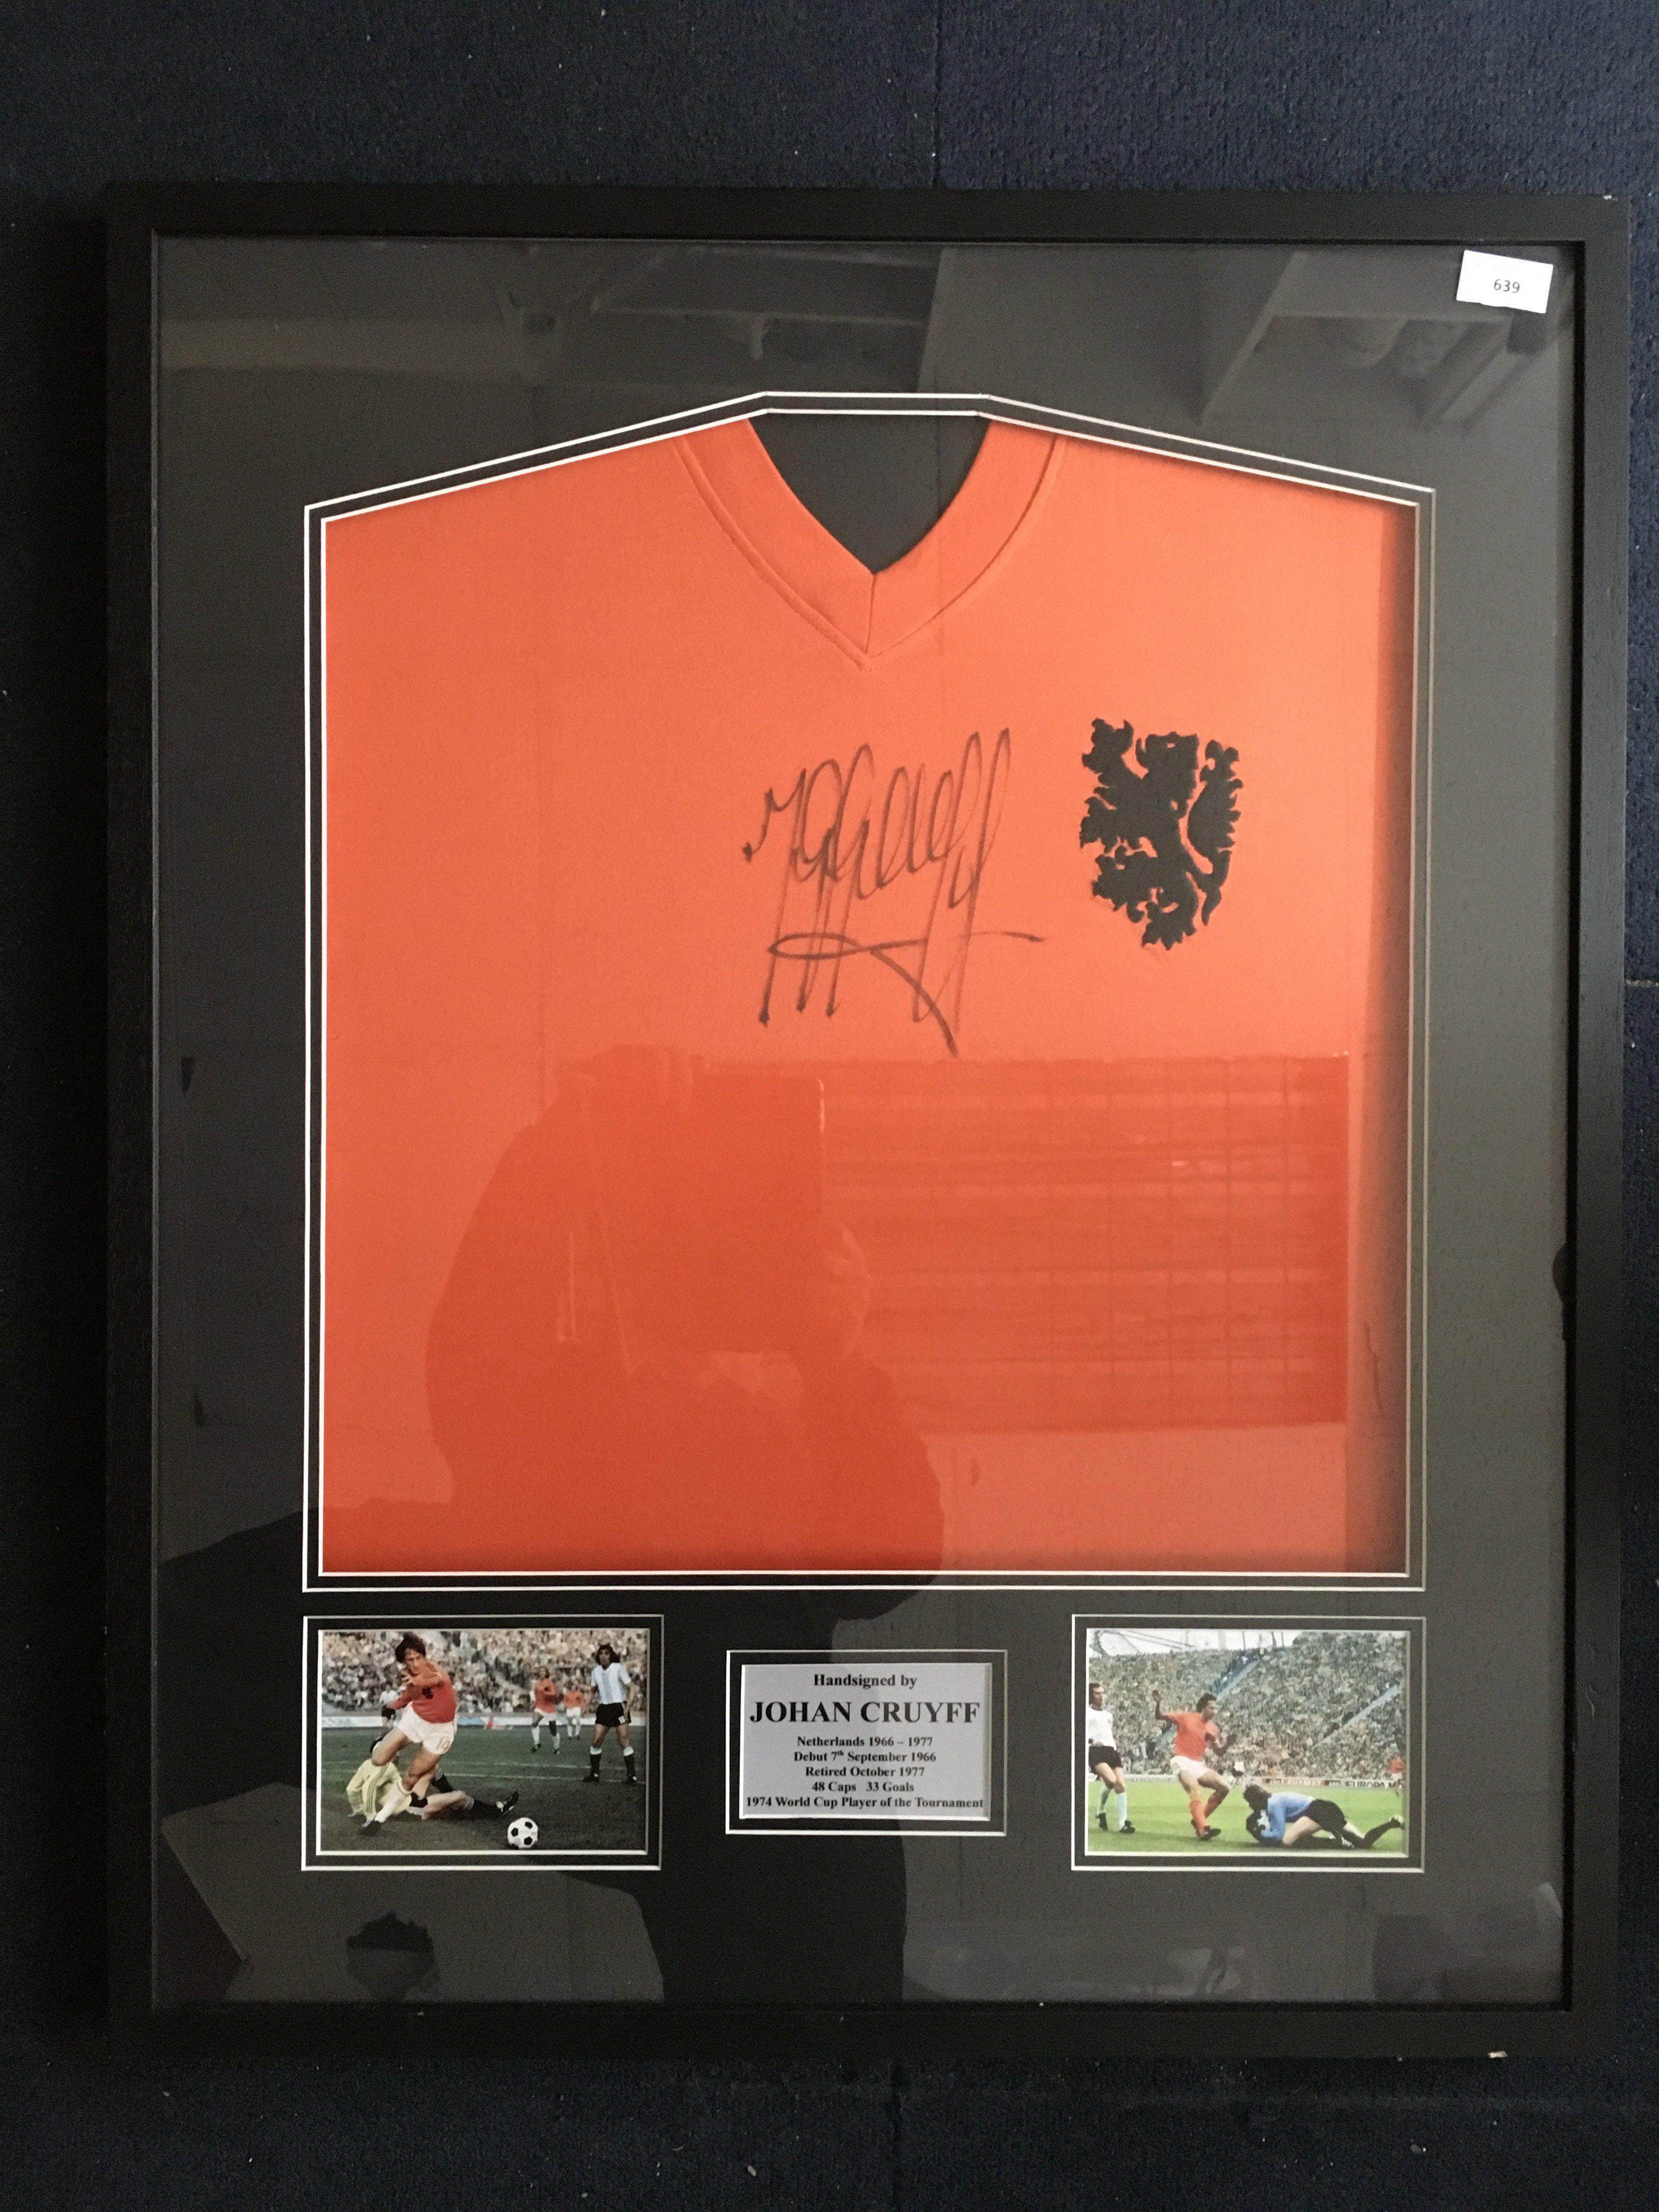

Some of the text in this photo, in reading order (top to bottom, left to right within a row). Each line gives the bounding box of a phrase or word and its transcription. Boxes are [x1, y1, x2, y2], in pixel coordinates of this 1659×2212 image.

[1493, 279, 1520, 293] 639
[814, 1674, 917, 1689] Handsigned by
[750, 1701, 980, 1723] JOHAN CRUYFF
[797, 1736, 865, 1746] Netherlands
[870, 1736, 894, 1747] 1966
[909, 1737, 933, 1747] 1977
[794, 1750, 937, 1764] Debut 7th September 1966
[805, 1766, 924, 1777] Retired October 1977
[812, 1781, 915, 1794] 48 Caps 33 Goals
[747, 1797, 984, 1809] 1974 World Cup Player of the Tournament
